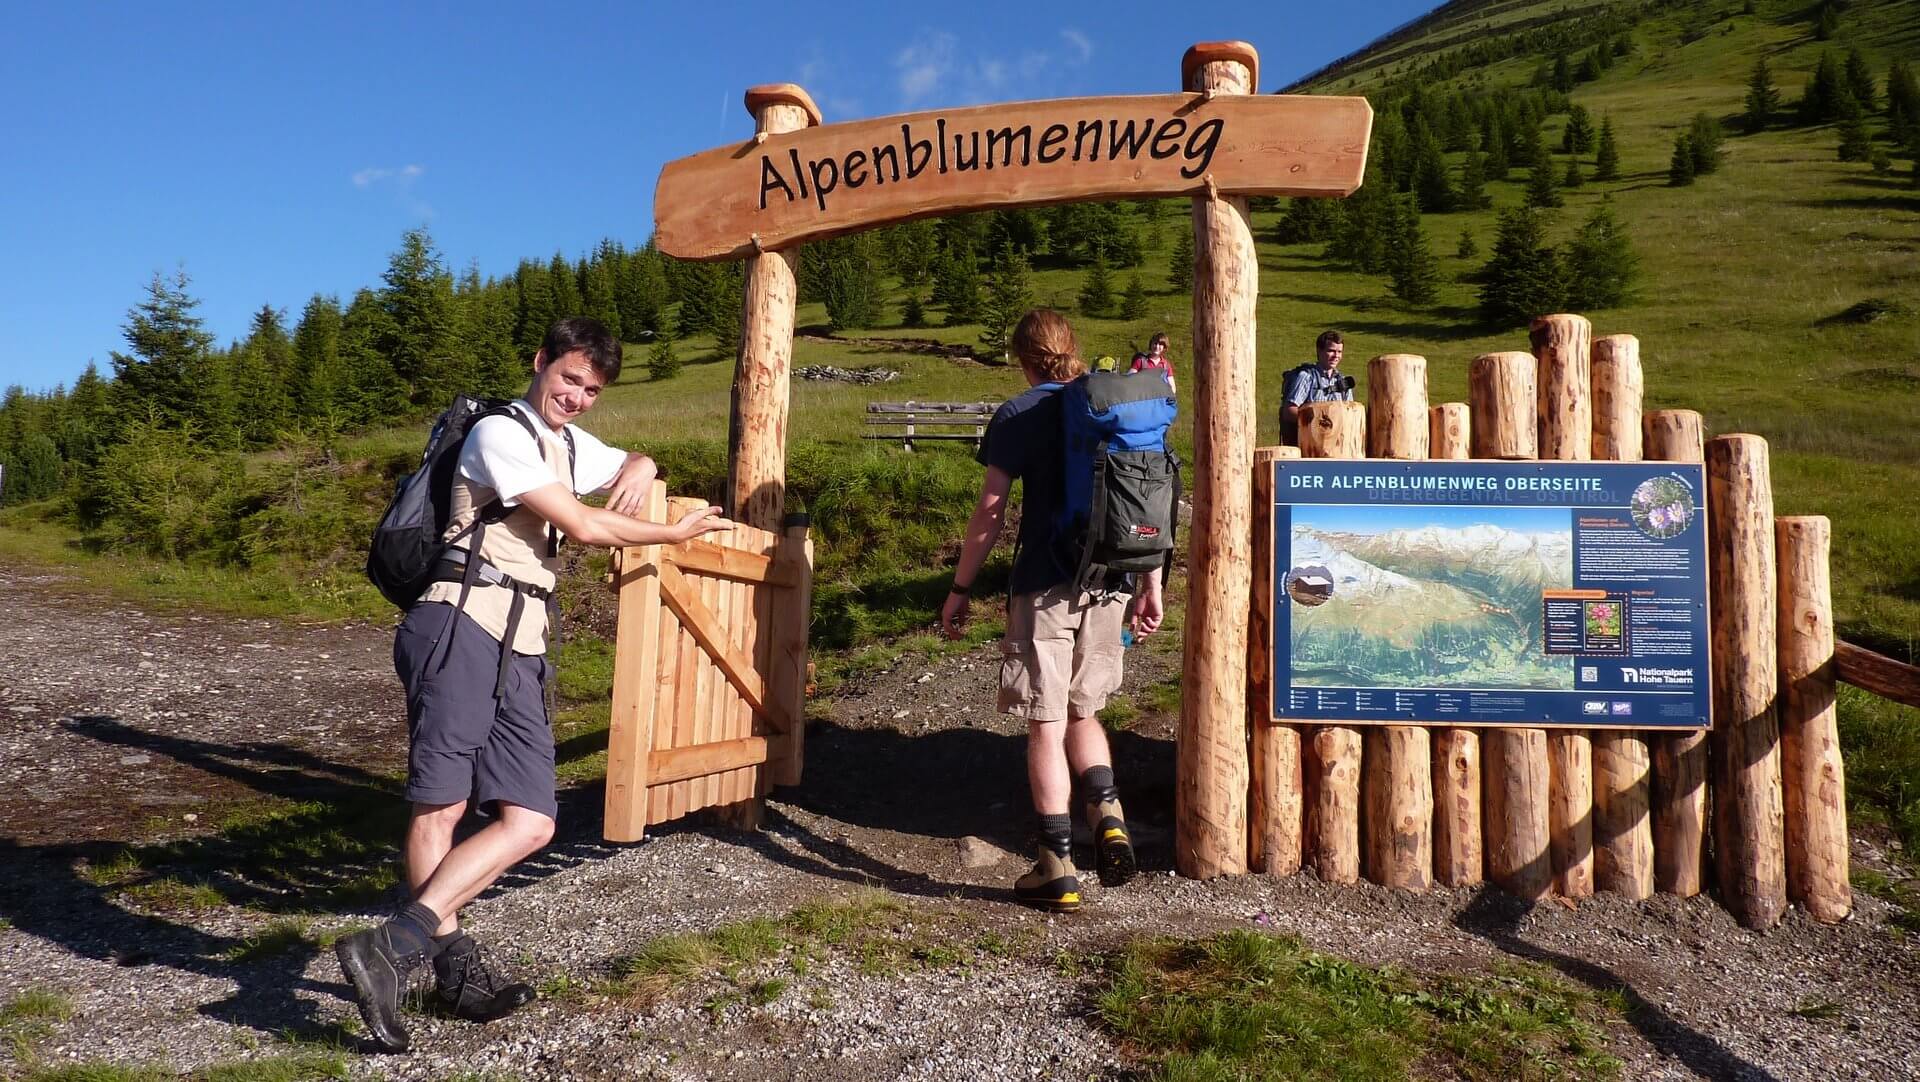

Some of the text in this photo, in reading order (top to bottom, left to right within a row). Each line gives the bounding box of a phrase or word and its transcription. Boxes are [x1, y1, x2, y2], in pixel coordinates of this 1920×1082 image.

[759, 118, 1225, 211] Alpenblumenweg
[1290, 475, 1602, 491] DER ALPENBLUMENWEG OBERSEITE
[1369, 489, 1513, 502] DEFEREGGENTAL
[1640, 667, 1693, 678] Nationalpark
[1640, 676, 1662, 684] Hohe
